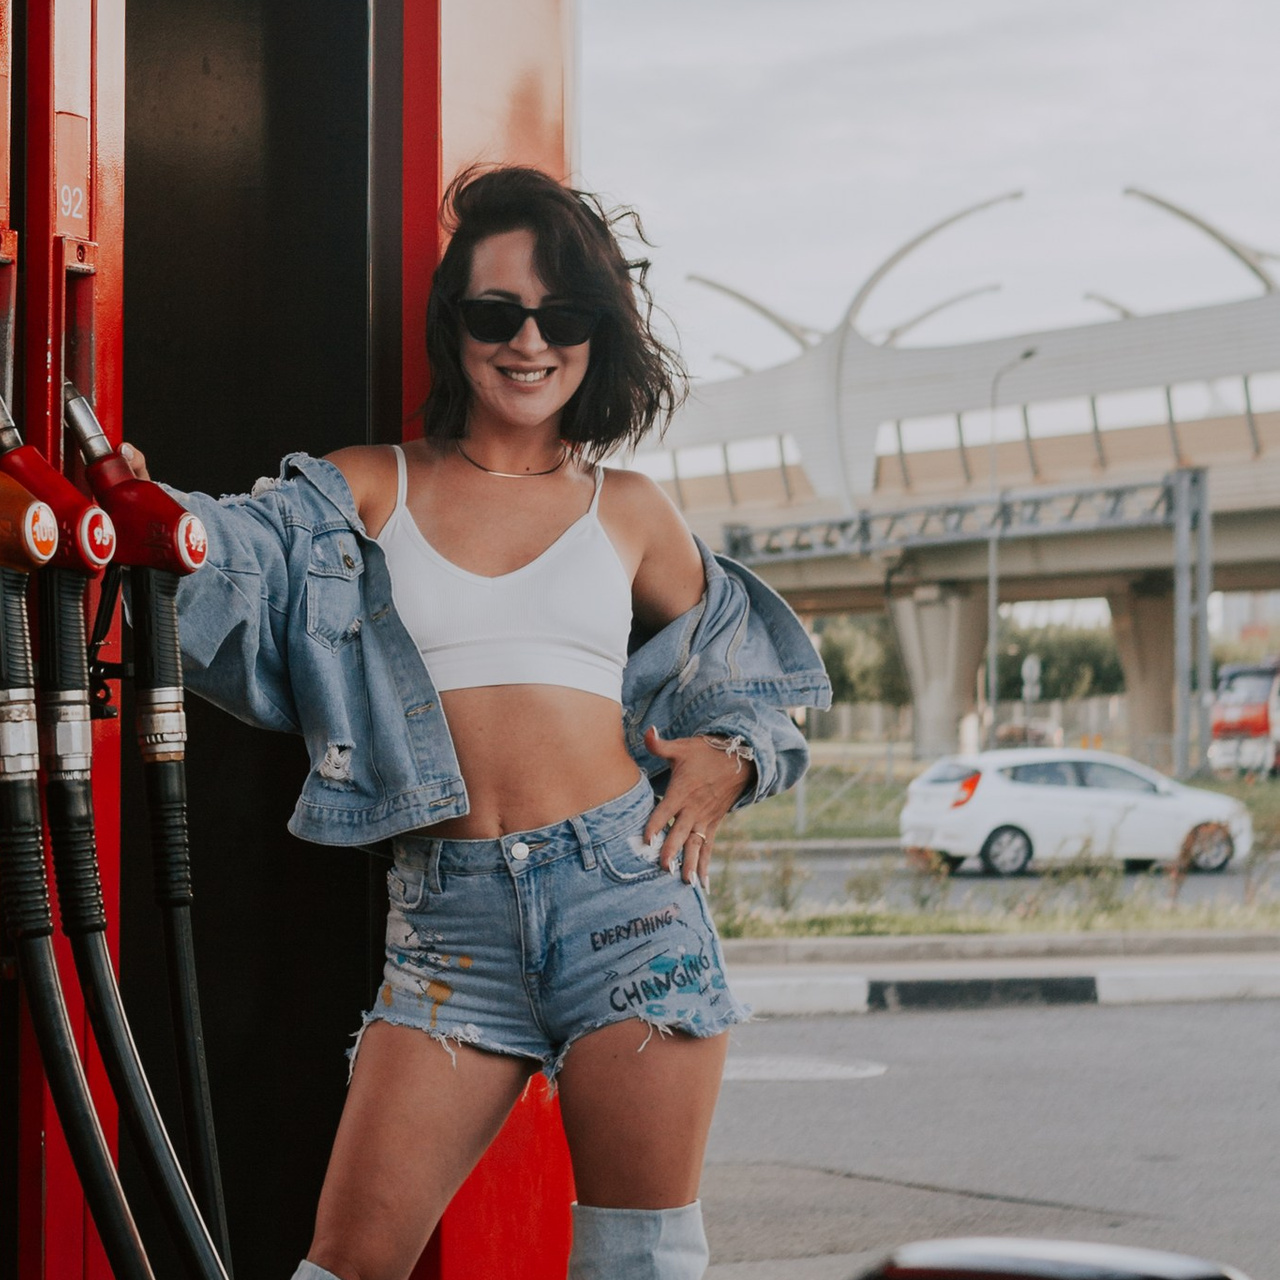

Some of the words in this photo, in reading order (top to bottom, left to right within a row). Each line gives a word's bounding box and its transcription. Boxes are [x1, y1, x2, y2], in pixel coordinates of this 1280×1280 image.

[60, 184, 83, 219] 92
[33, 522, 56, 542] 100
[93, 526, 111, 546] 95
[189, 532, 204, 553] 92
